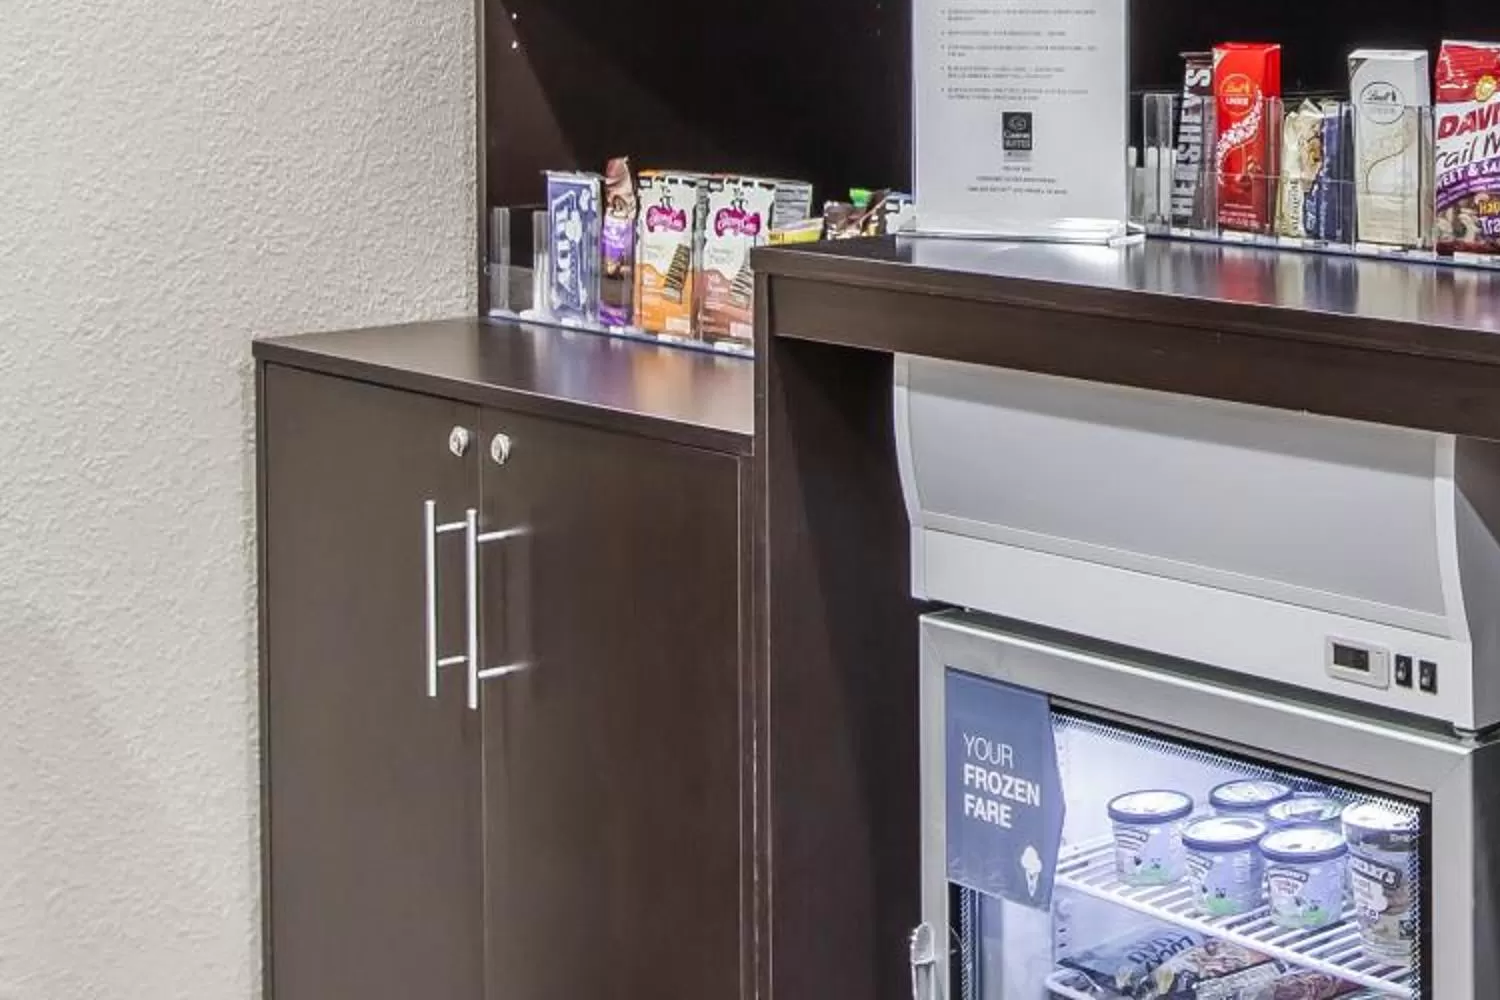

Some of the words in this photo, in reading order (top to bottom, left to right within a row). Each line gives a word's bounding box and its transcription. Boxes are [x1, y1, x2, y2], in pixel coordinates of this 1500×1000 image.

[1436, 136, 1477, 169] rail
[963, 733, 1014, 769] YOUR
[963, 763, 1040, 807] FROZEN
[964, 793, 1013, 828] FARE
